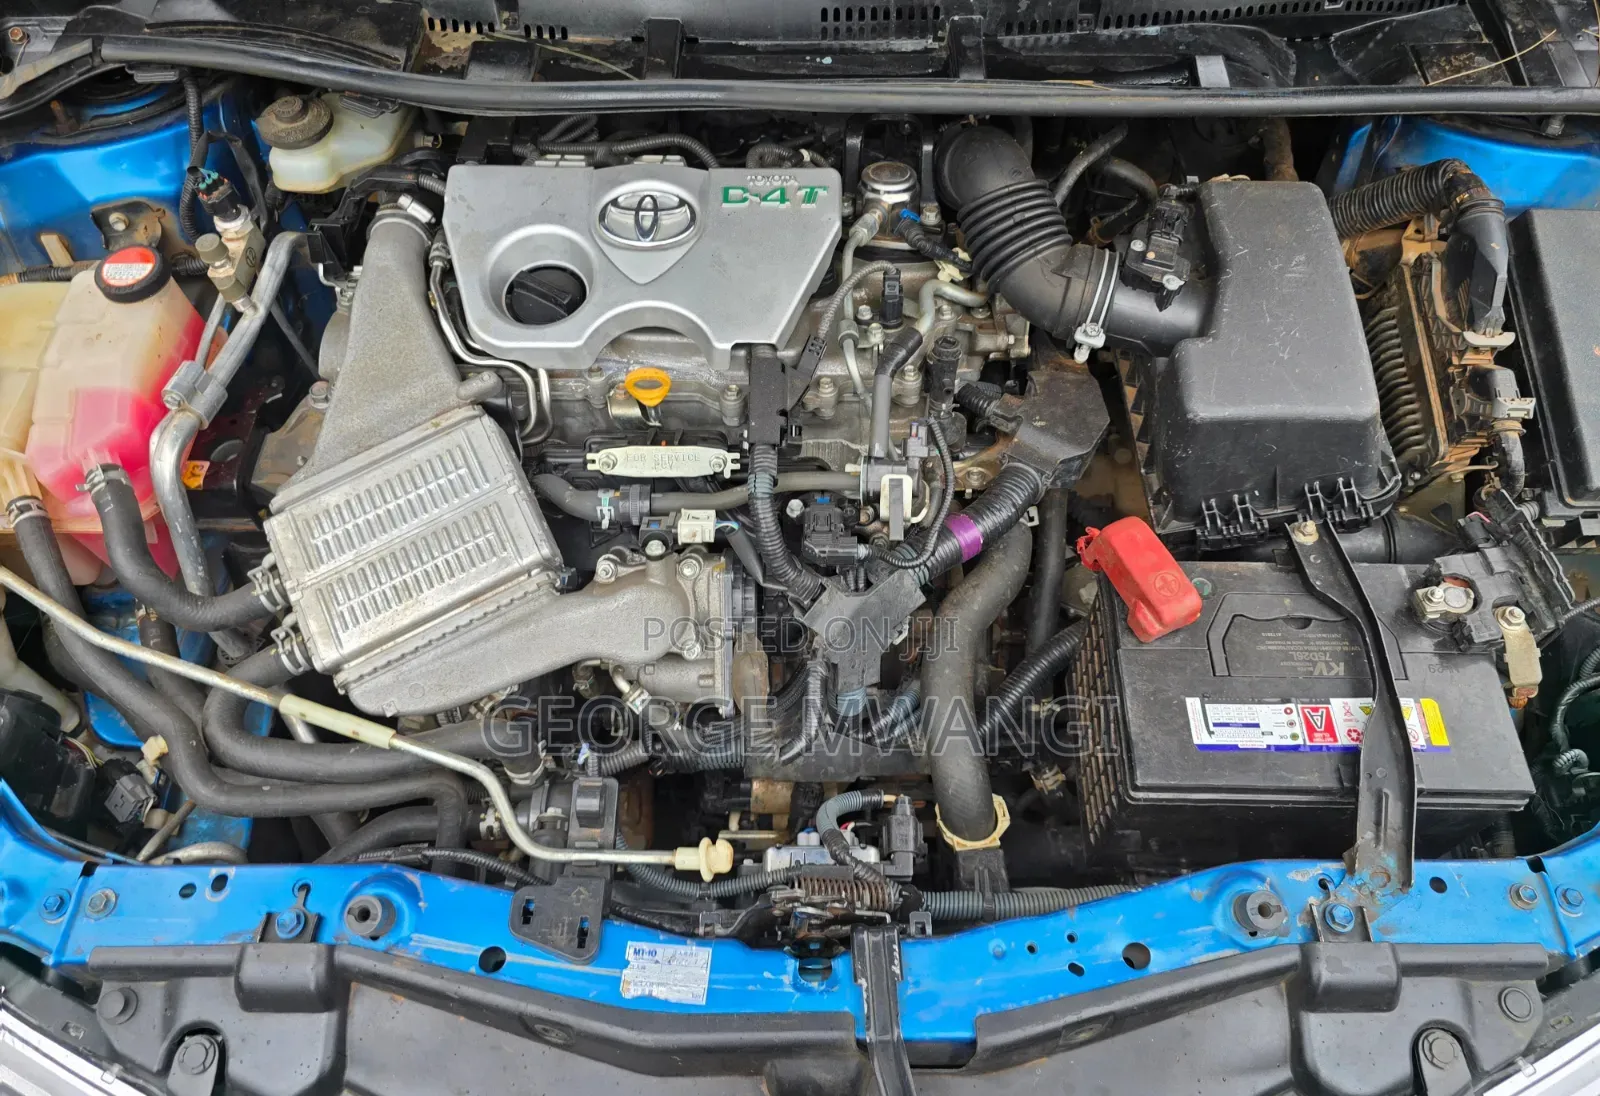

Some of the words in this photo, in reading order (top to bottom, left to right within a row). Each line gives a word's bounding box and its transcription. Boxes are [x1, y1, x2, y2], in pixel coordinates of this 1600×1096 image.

[747, 175, 798, 186] TOYOTA
[626, 453, 647, 462] FOR
[653, 453, 701, 462] SERVICE
[1289, 651, 1333, 661] 75D26L
[1312, 661, 1345, 676] KV
[1304, 708, 1326, 731] A
